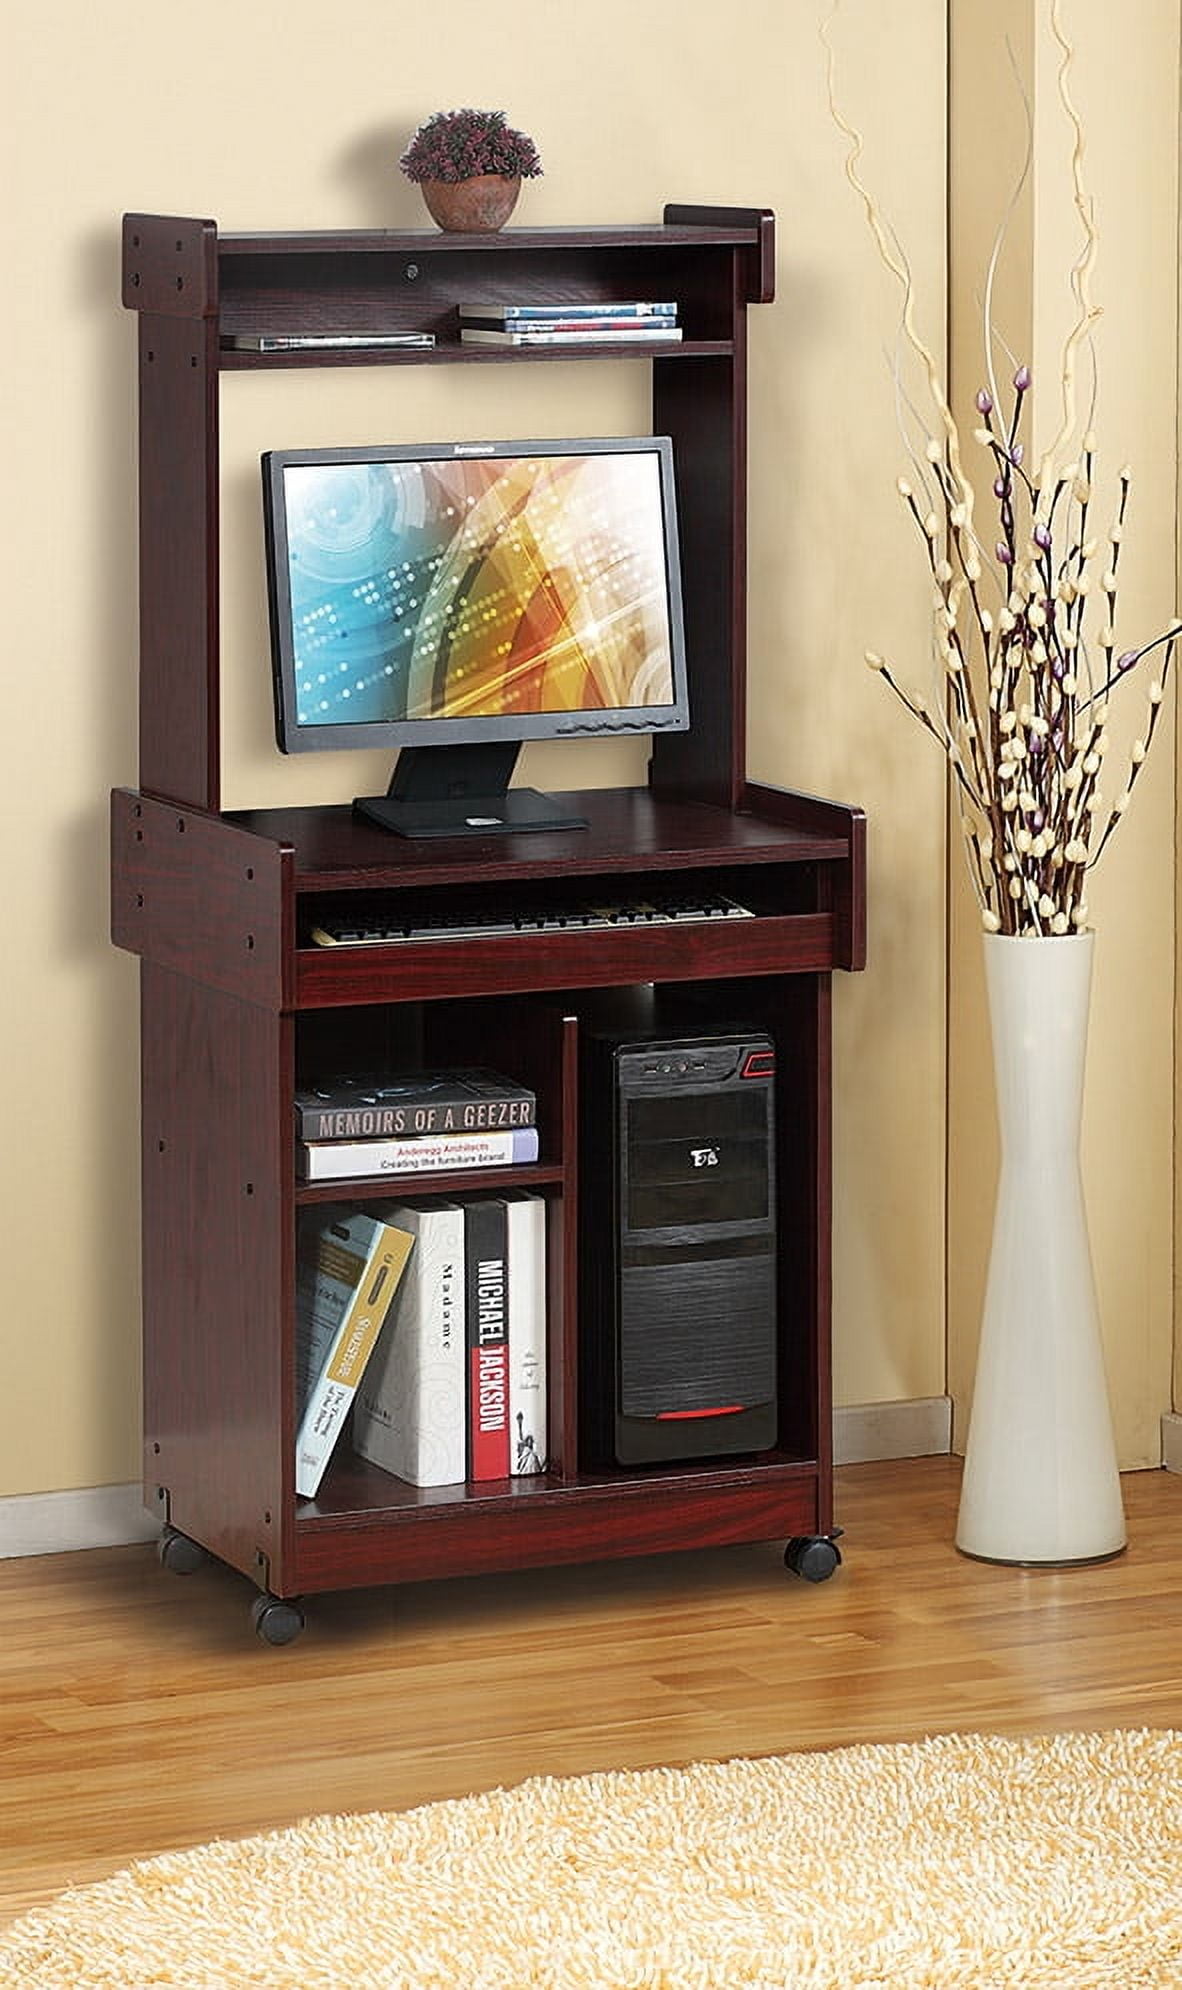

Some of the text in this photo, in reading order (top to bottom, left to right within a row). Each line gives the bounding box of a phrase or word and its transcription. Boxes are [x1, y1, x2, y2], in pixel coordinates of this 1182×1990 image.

[319, 1102, 530, 1137] MEMOIRS OF A GEEZER
[443, 1263, 453, 1349] Madame
[478, 1260, 505, 1432] MICHAEL JACKSON
